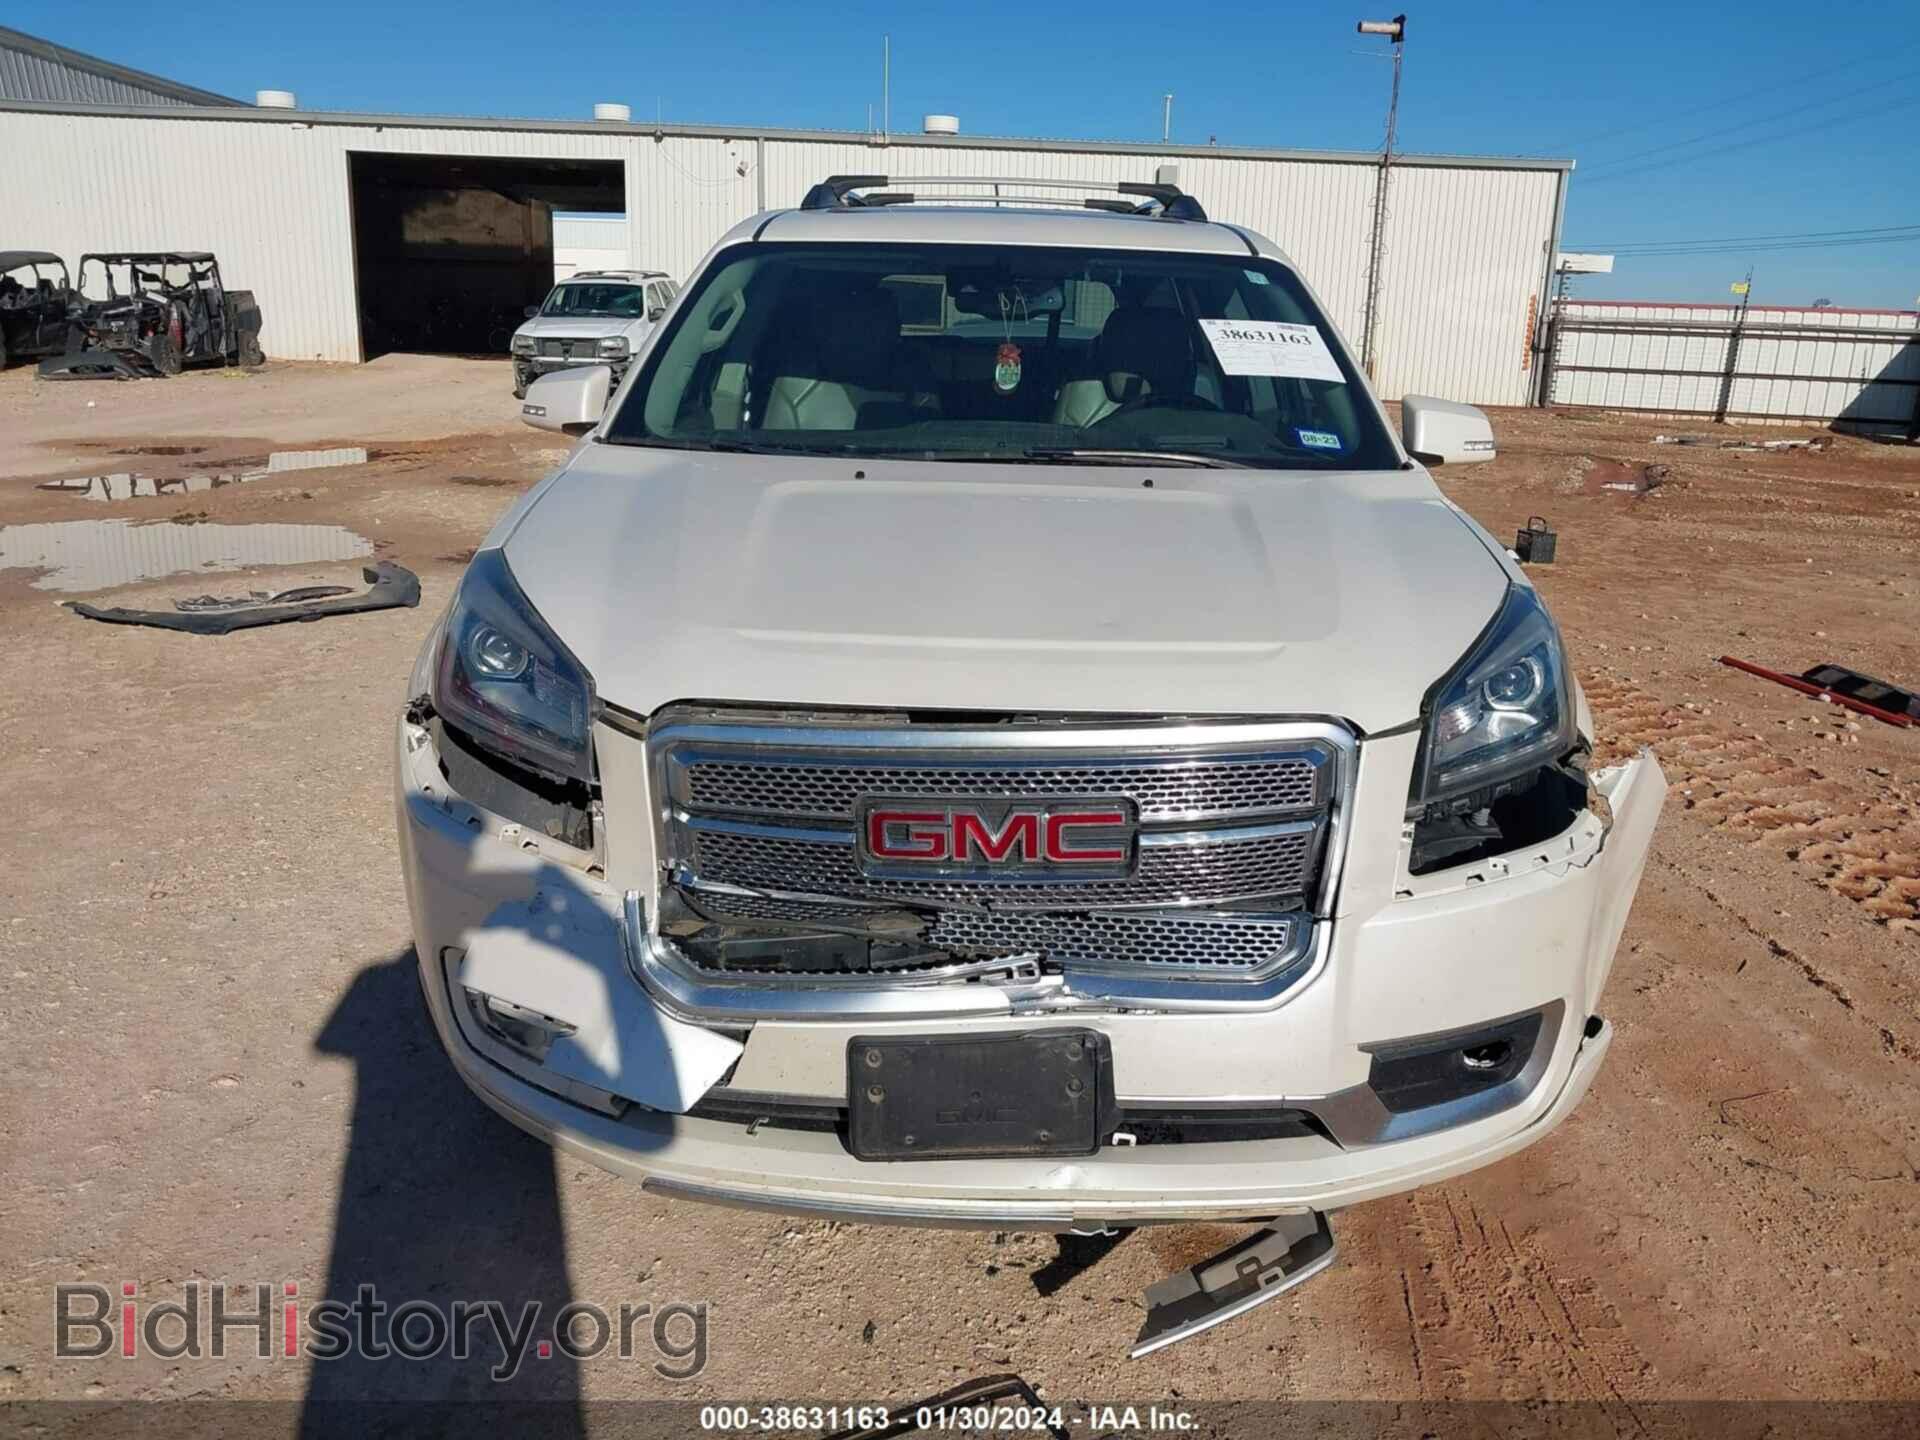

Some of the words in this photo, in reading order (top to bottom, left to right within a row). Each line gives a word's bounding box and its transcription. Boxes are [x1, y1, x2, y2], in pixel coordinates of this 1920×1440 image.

[1217, 328, 1312, 346] 38631163
[1302, 433, 1338, 446] 08-23
[869, 810, 1126, 863] GMC
